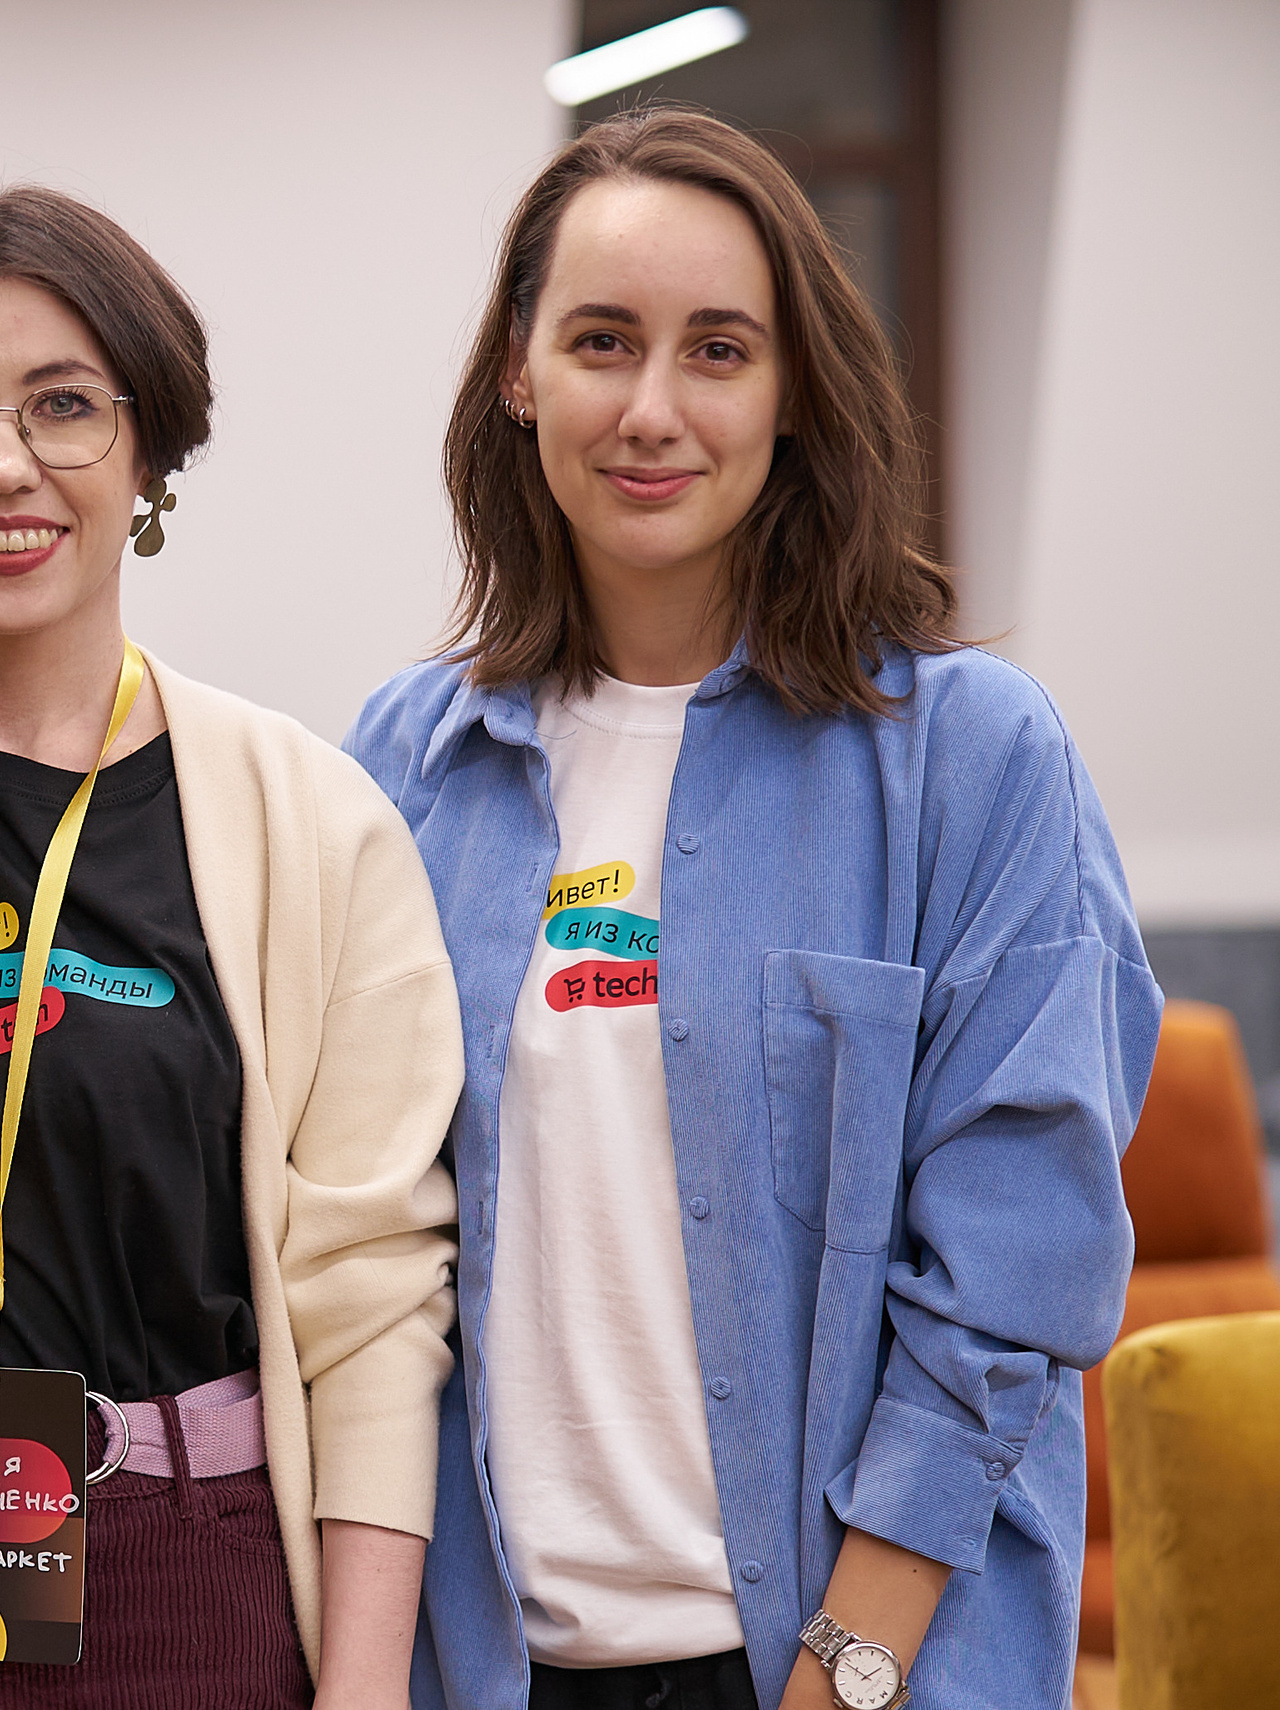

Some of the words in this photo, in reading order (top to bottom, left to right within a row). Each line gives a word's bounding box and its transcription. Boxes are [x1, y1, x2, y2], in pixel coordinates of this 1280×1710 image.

[565, 922, 580, 940] я
[585, 921, 619, 943] из
[43, 963, 153, 999] манды
[593, 967, 657, 998] tech
